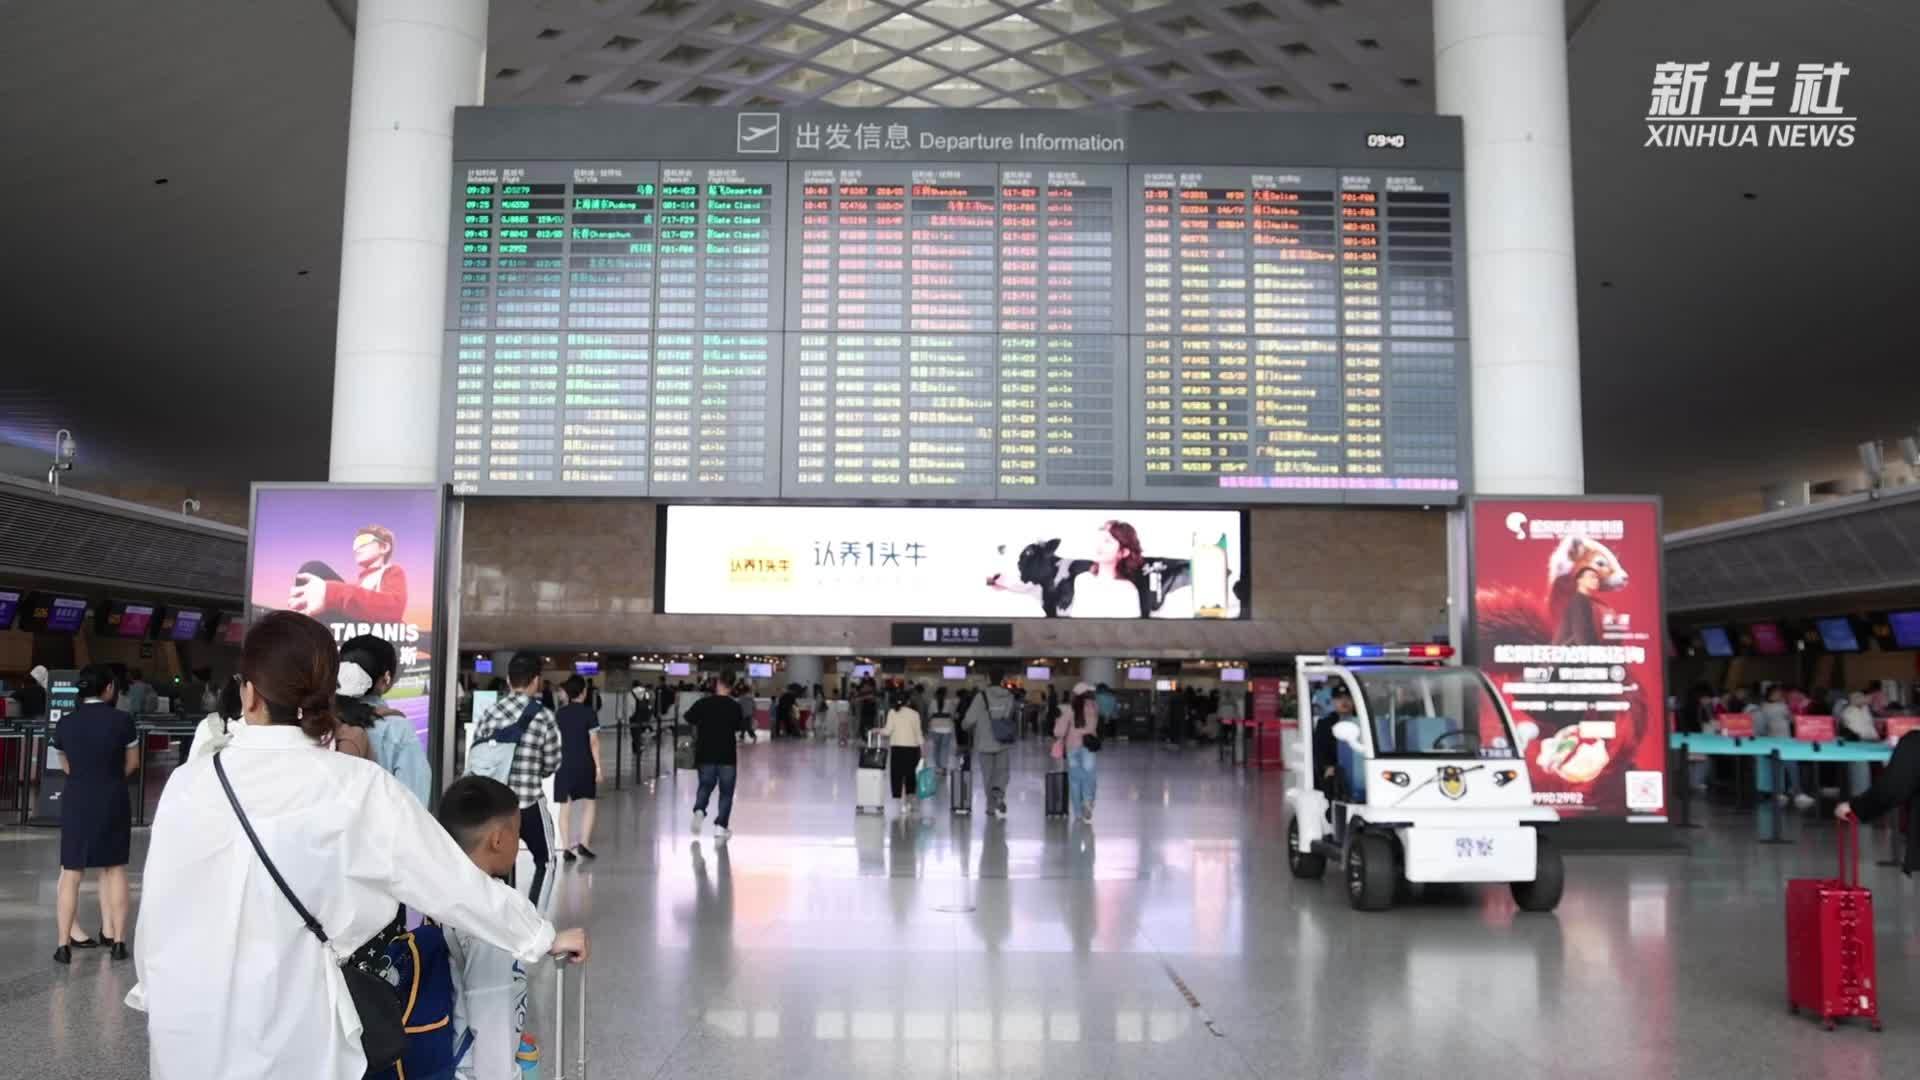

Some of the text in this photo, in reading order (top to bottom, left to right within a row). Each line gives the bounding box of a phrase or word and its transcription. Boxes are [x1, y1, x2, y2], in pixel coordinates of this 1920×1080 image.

[796, 123, 1124, 152] 出发信息 Departure Information
[814, 541, 928, 567] 认养1头牛
